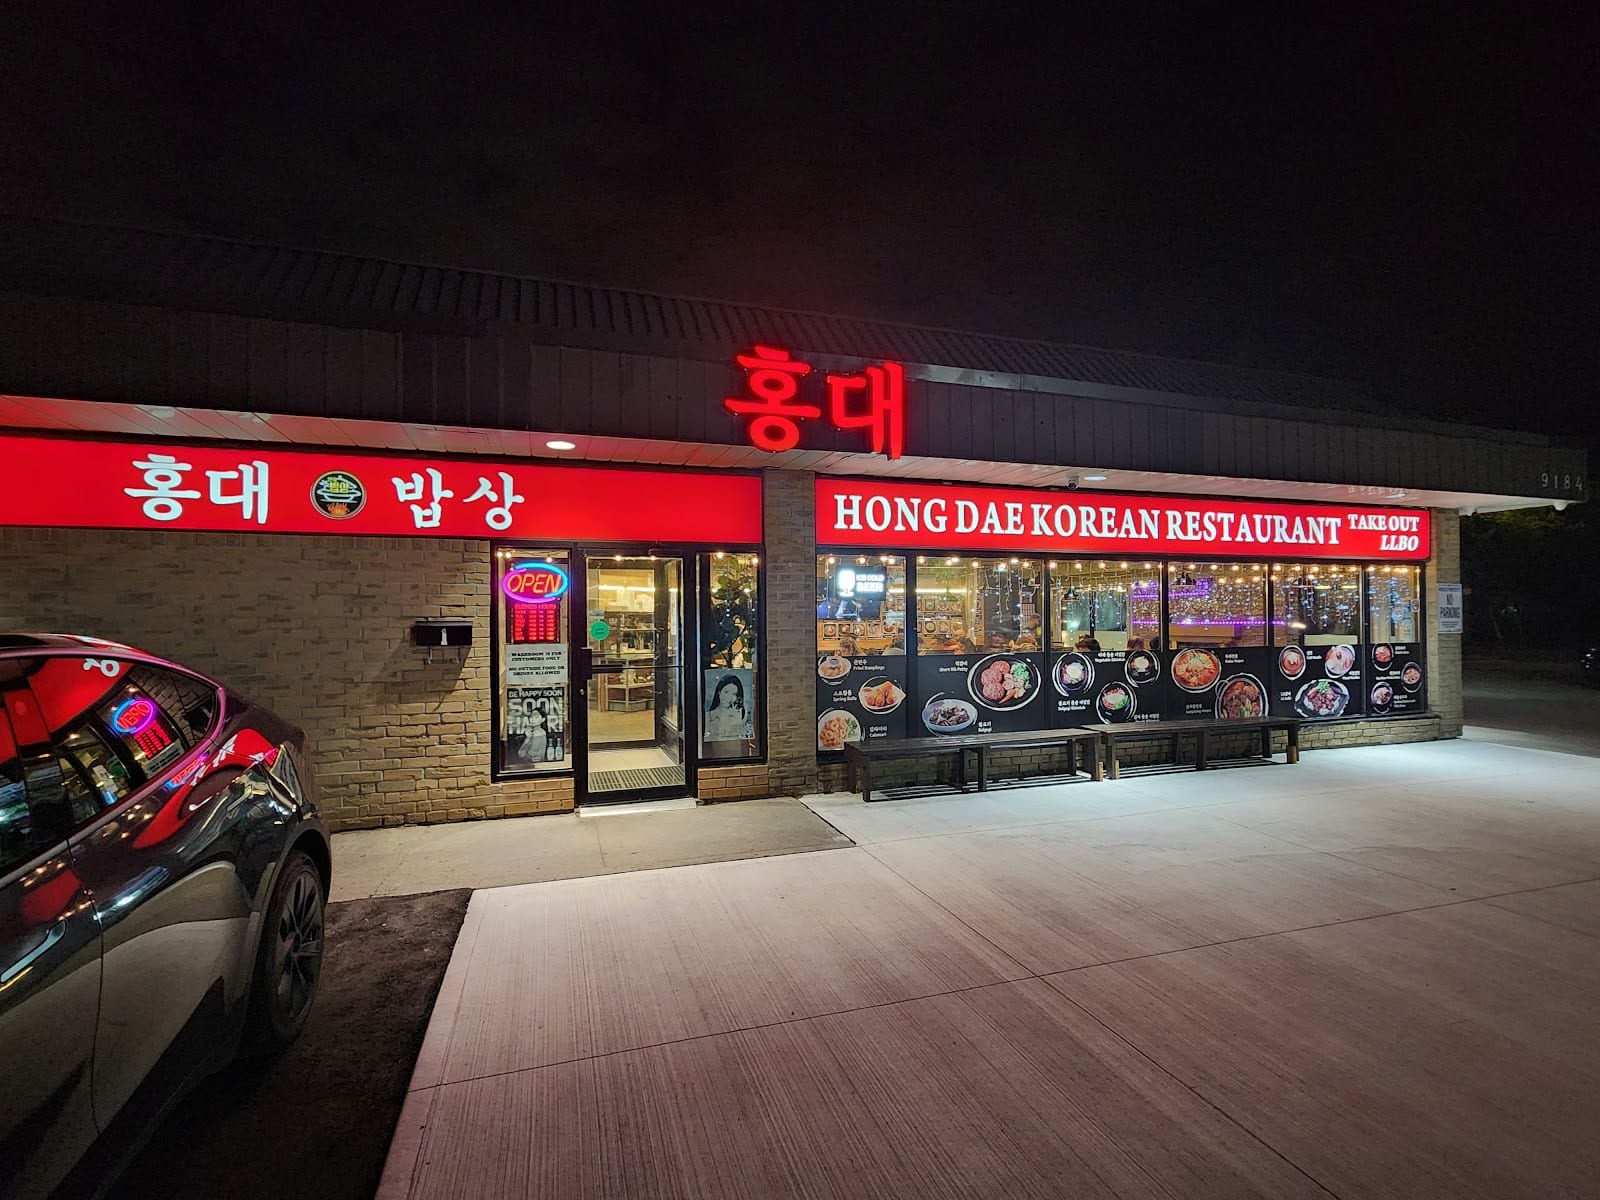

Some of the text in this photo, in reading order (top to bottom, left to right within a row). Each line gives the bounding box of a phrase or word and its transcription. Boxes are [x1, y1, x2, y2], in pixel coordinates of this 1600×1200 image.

[724, 345, 904, 460] 홍대
[1541, 472, 1583, 491] 9184
[123, 453, 525, 531] 홍대 밥상
[833, 494, 1342, 545] HONG DAE KOREAN RESTAURANT
[1347, 513, 1420, 532] TAKE OUT
[1379, 534, 1419, 551] LLBO
[507, 573, 562, 593] OPEN
[440, 627, 448, 646] 1
[543, 689, 563, 697] SOON
[508, 697, 563, 716] SOON
